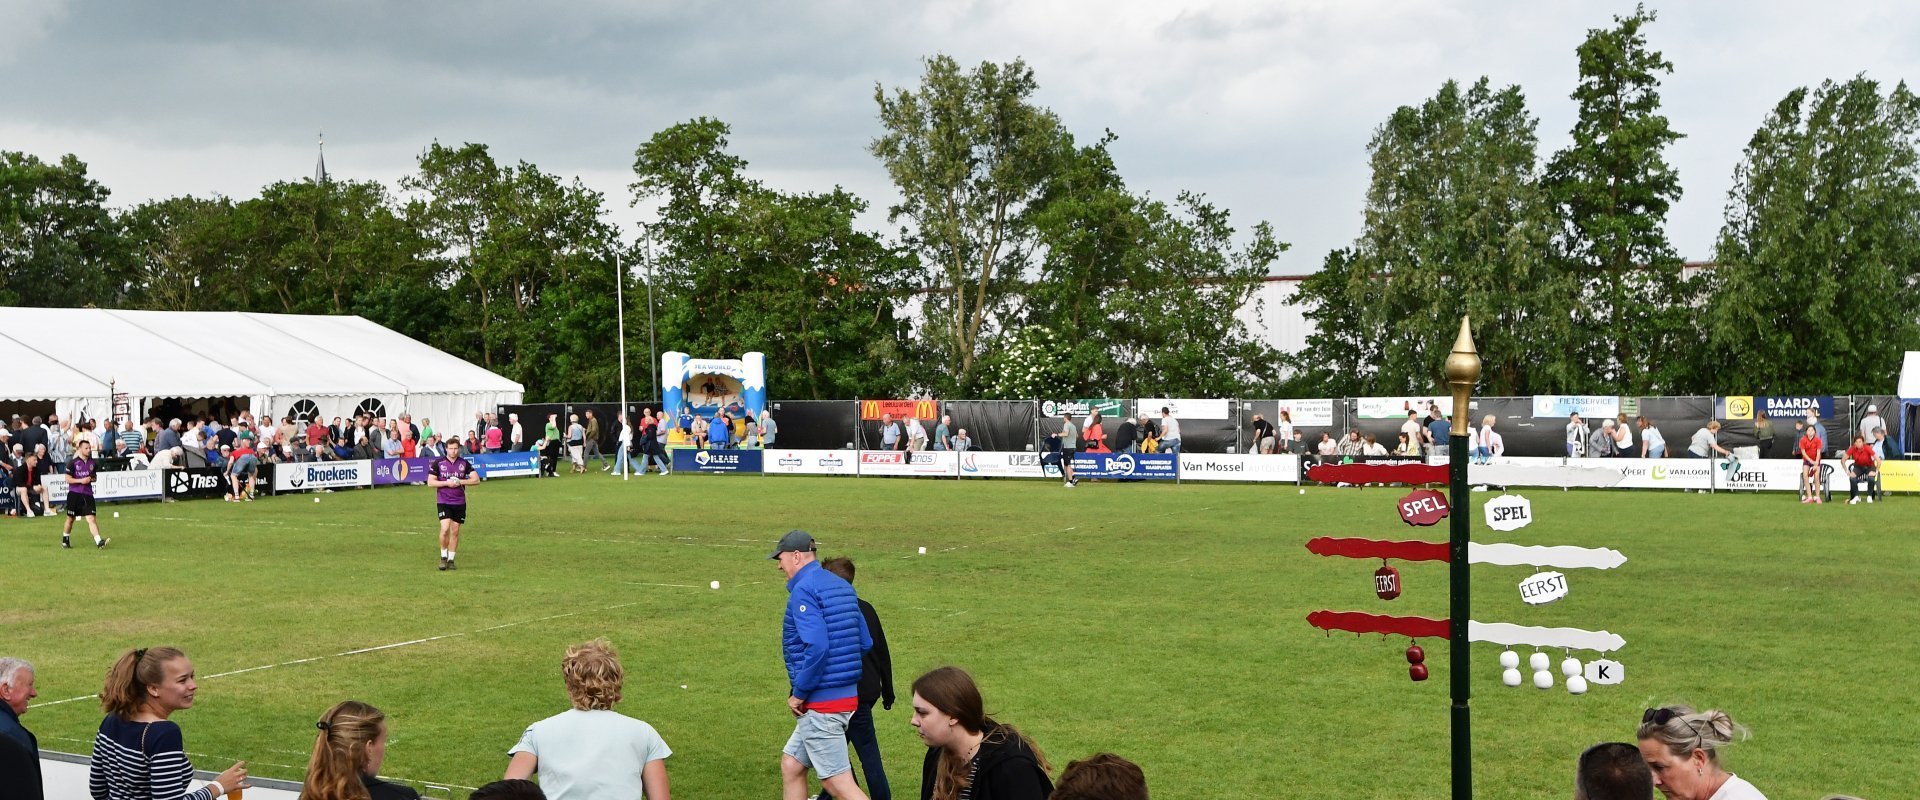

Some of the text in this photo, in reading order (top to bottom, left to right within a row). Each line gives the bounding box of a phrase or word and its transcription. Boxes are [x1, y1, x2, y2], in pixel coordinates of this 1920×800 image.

[1559, 397, 1611, 405] FIETSSERVICE
[1767, 398, 1820, 408] BAARDA
[867, 454, 896, 463] FOPPE
[1105, 457, 1132, 471] REPKO
[1182, 461, 1203, 471] Van
[1206, 461, 1244, 472] Mossel
[307, 466, 358, 482] Broekens
[1669, 468, 1686, 476] VAN
[1733, 471, 1768, 482] OREEL
[105, 472, 148, 489] fritom
[190, 473, 218, 489] TRES
[1402, 496, 1447, 518] SPEL
[1493, 505, 1528, 522] SPEL
[1375, 573, 1396, 593] EERST
[1520, 574, 1564, 598] EERST
[1598, 664, 1610, 680] K
